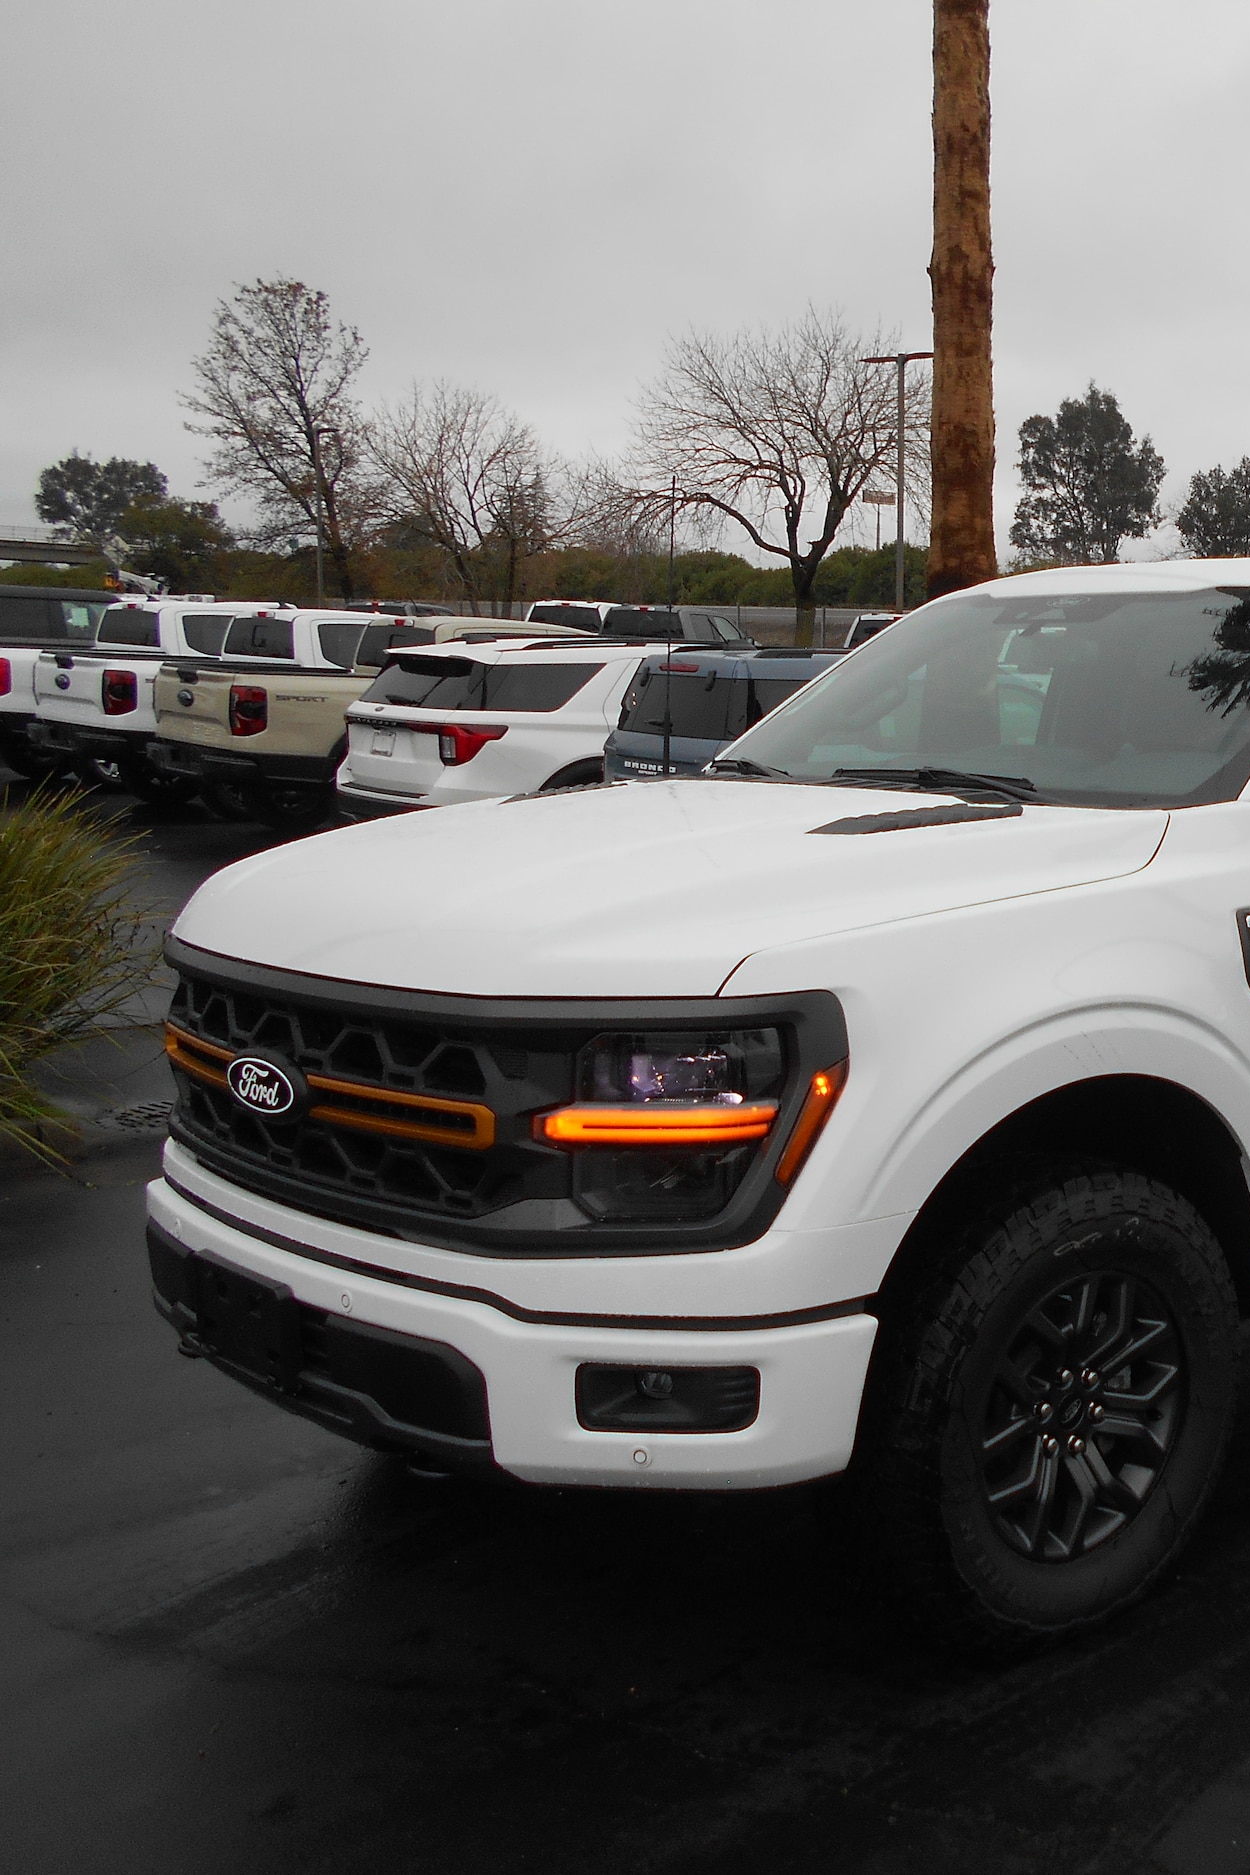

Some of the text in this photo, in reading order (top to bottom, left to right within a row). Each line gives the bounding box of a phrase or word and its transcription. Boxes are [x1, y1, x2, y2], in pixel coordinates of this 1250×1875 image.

[275, 694, 329, 703] SPORT
[624, 761, 677, 773] BRONCO
[239, 1064, 279, 1106] Ford
